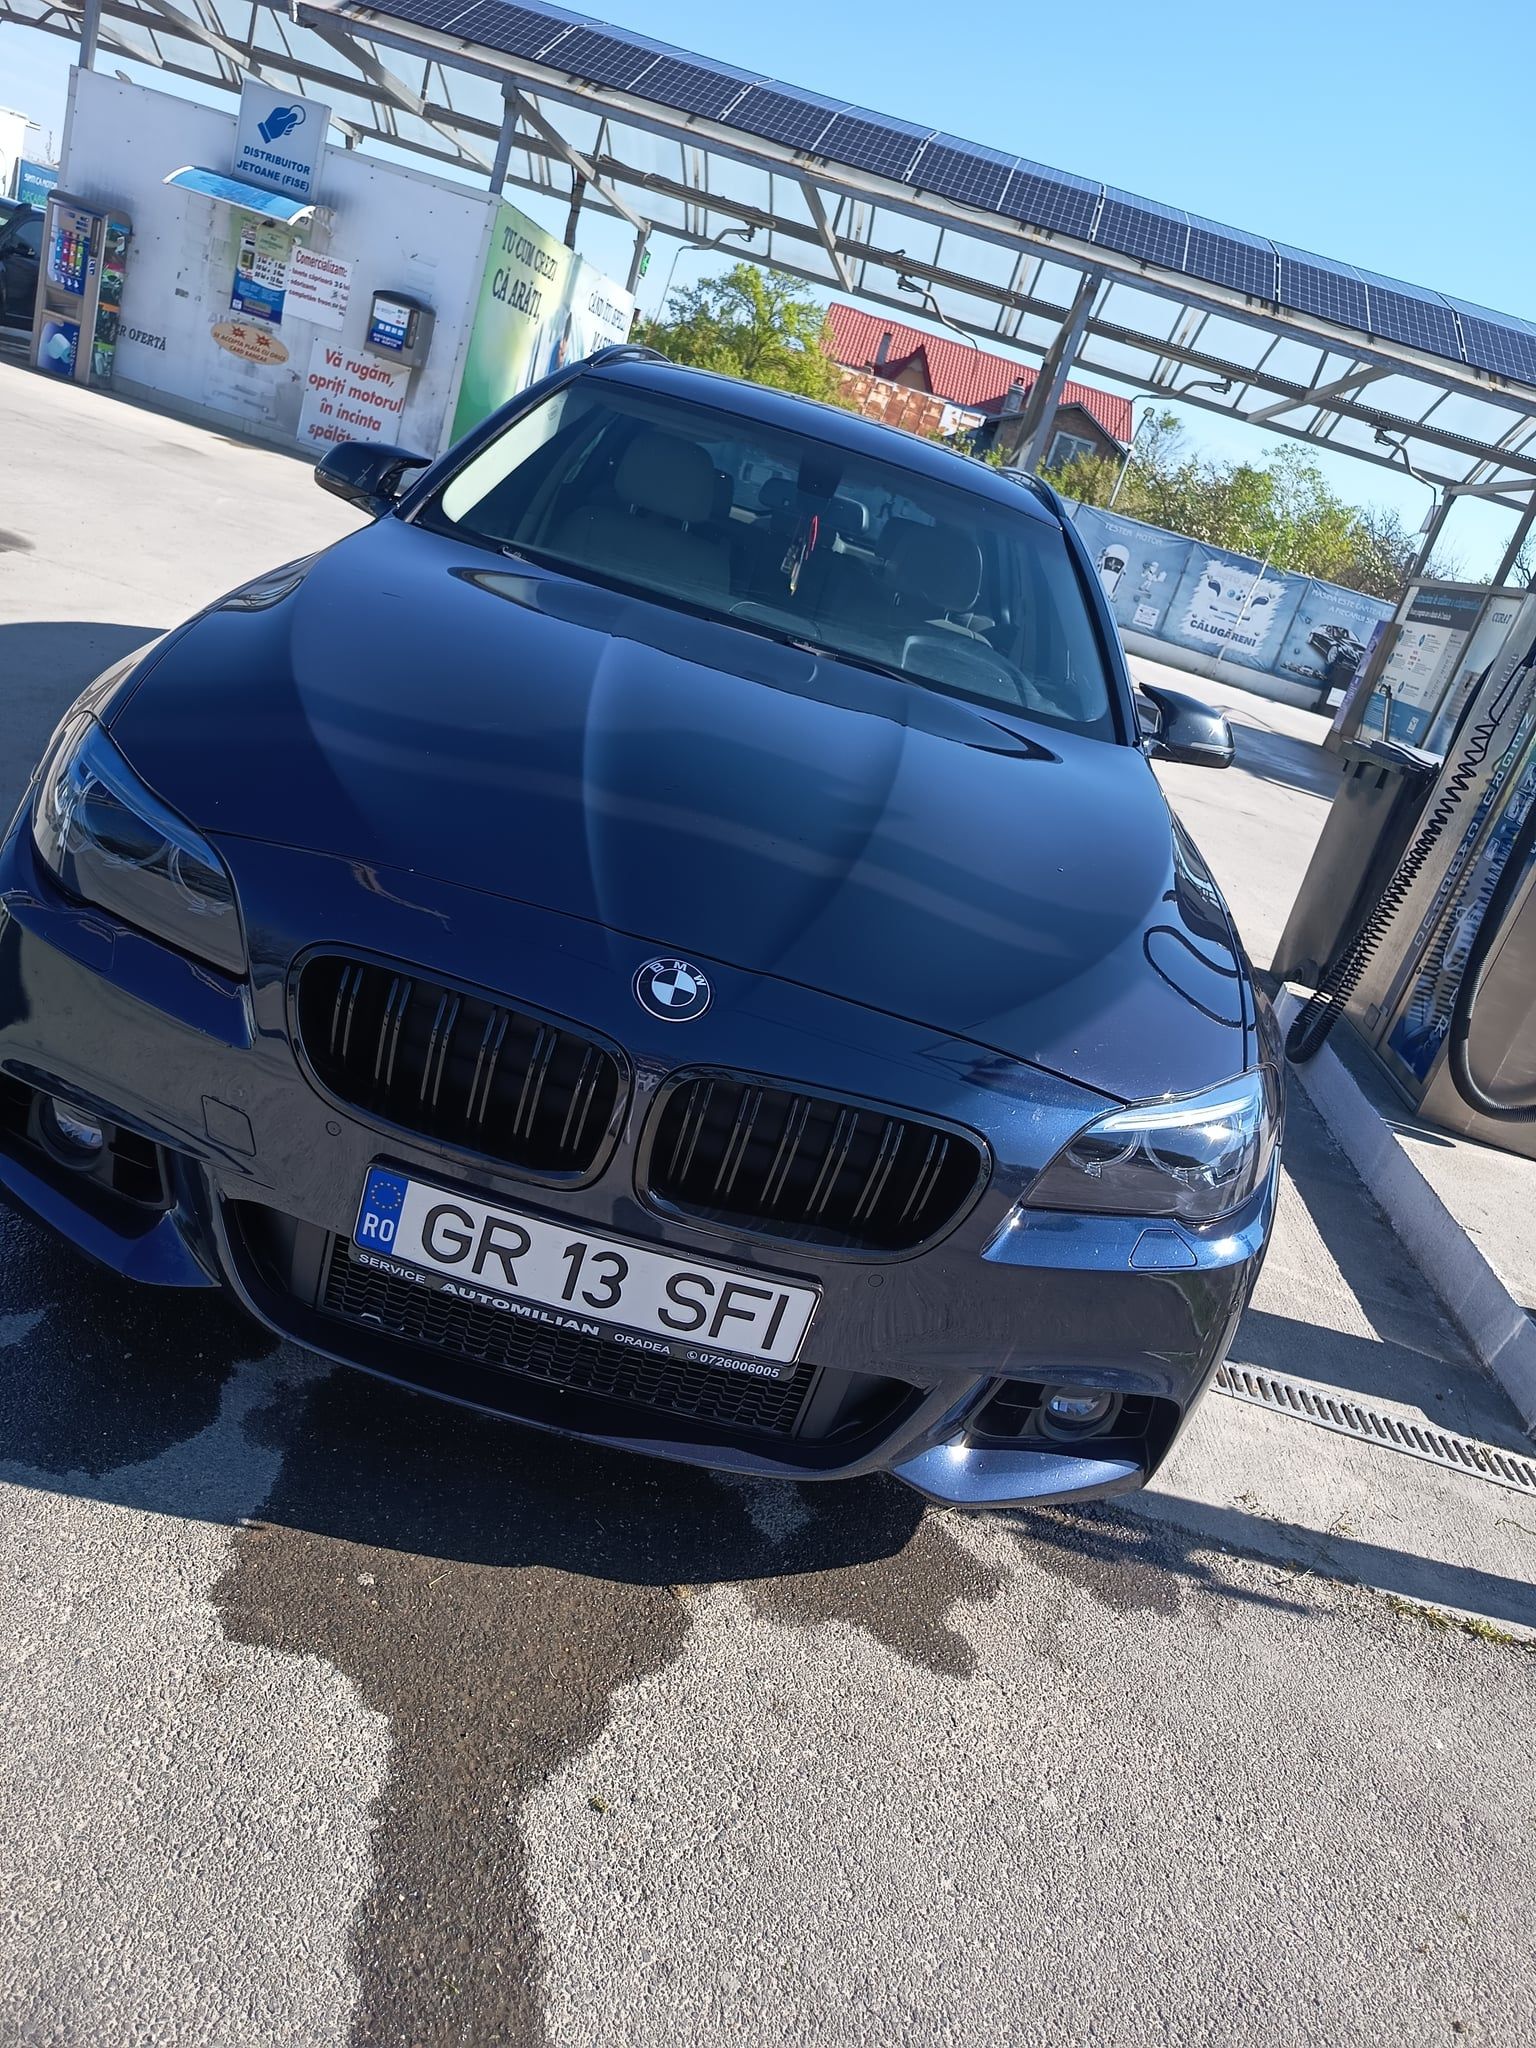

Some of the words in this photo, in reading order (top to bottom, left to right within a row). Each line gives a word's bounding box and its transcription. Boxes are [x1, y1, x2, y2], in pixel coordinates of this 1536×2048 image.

[236, 160, 281, 181] JETOANE
[243, 145, 311, 175] DISTRIBUITOR
[502, 226, 518, 251] TU
[516, 238, 535, 268] CUM
[534, 249, 559, 282] CREZI
[128, 328, 168, 352] OFERTĂ
[325, 348, 344, 368] Vă
[345, 359, 394, 388] rugăm,
[319, 397, 334, 416] în
[336, 403, 382, 432] incinta
[348, 386, 404, 414] motorul
[1190, 619, 1257, 648] CĂLUGĂRENI
[649, 961, 707, 987] BMW
[362, 1212, 395, 1243] RO
[421, 1204, 532, 1287] GR
[560, 1241, 630, 1310] 13
[657, 1272, 789, 1351] SFI
[358, 1253, 427, 1285] SERVICE
[439, 1282, 601, 1337] AUTOMILIAN
[613, 1332, 672, 1356] ORADEA
[699, 1352, 781, 1380] 0726006005
